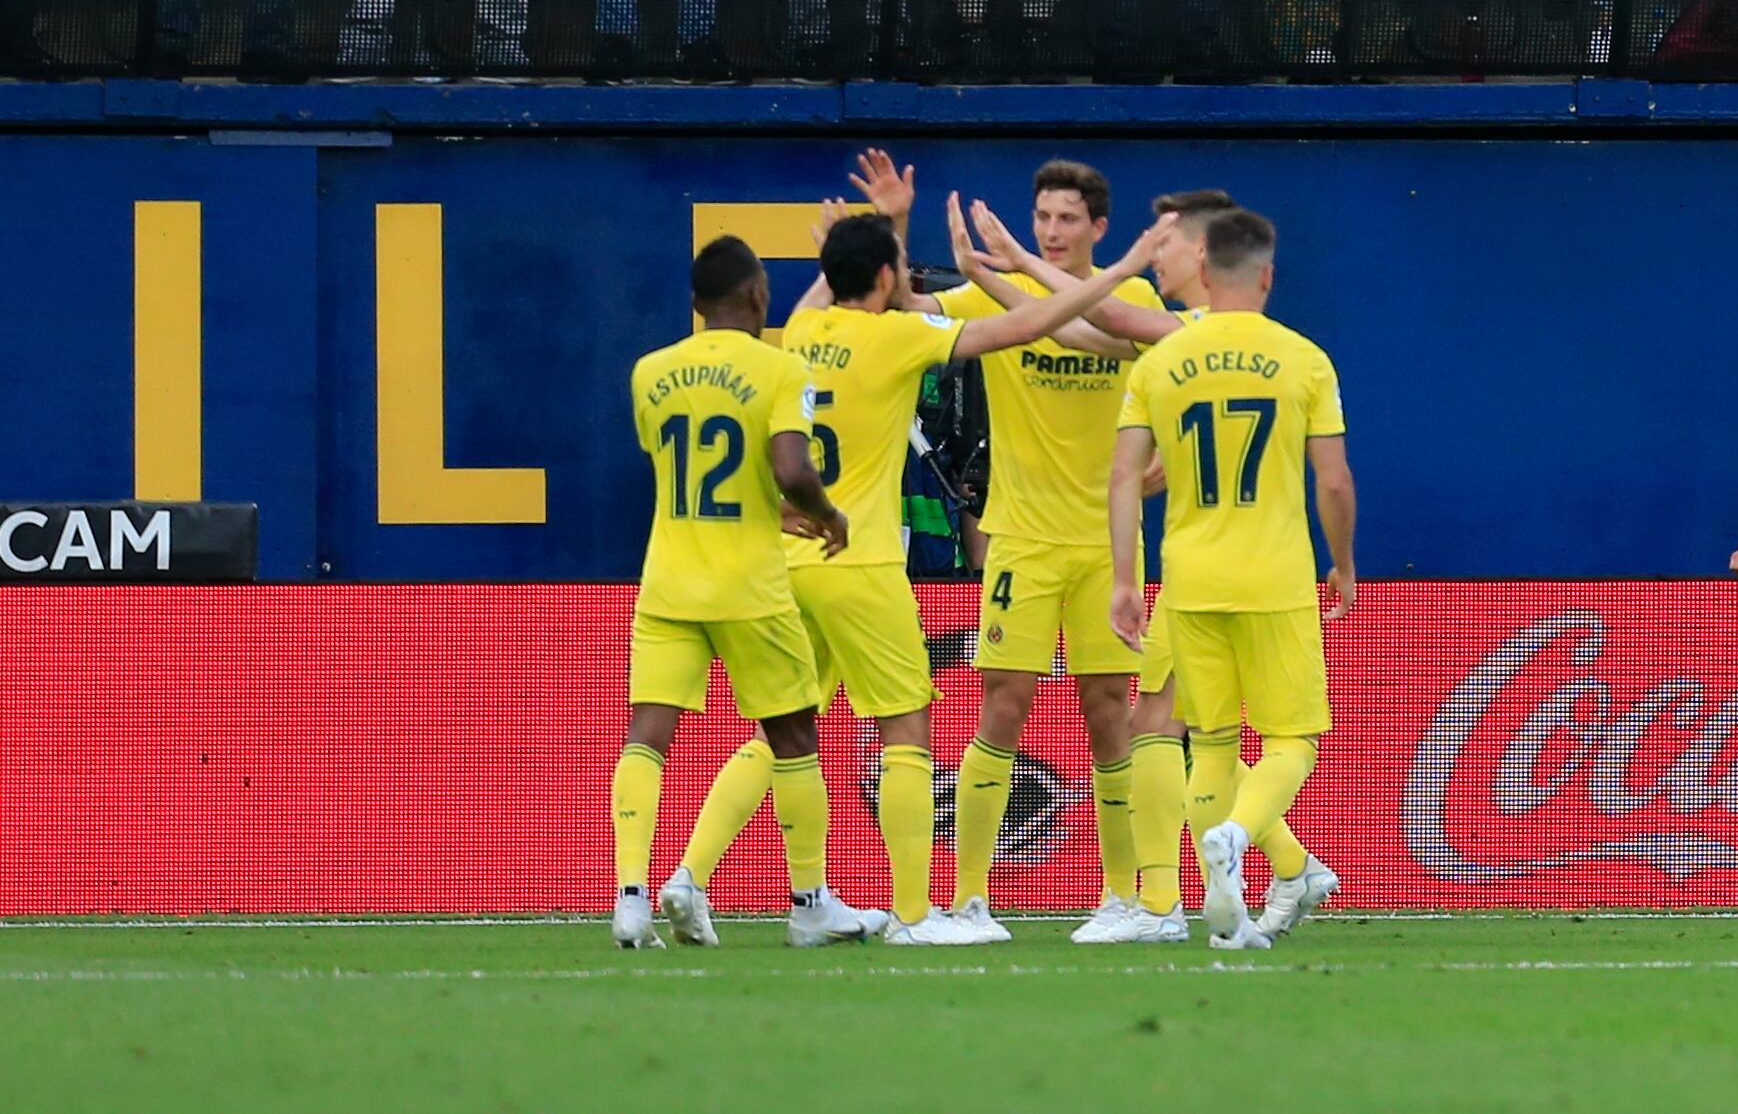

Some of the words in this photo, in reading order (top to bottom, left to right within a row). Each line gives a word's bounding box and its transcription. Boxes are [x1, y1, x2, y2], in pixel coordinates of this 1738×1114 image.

[787, 341, 852, 370] REJO
[1020, 349, 1122, 375] PAMESA
[1168, 357, 1200, 386] LO
[1205, 350, 1281, 380] CELSO
[807, 389, 842, 488] 5
[1177, 396, 1278, 508] 17
[657, 414, 746, 523] 12
[0, 509, 172, 572] CAM
[991, 570, 1013, 611] 4
